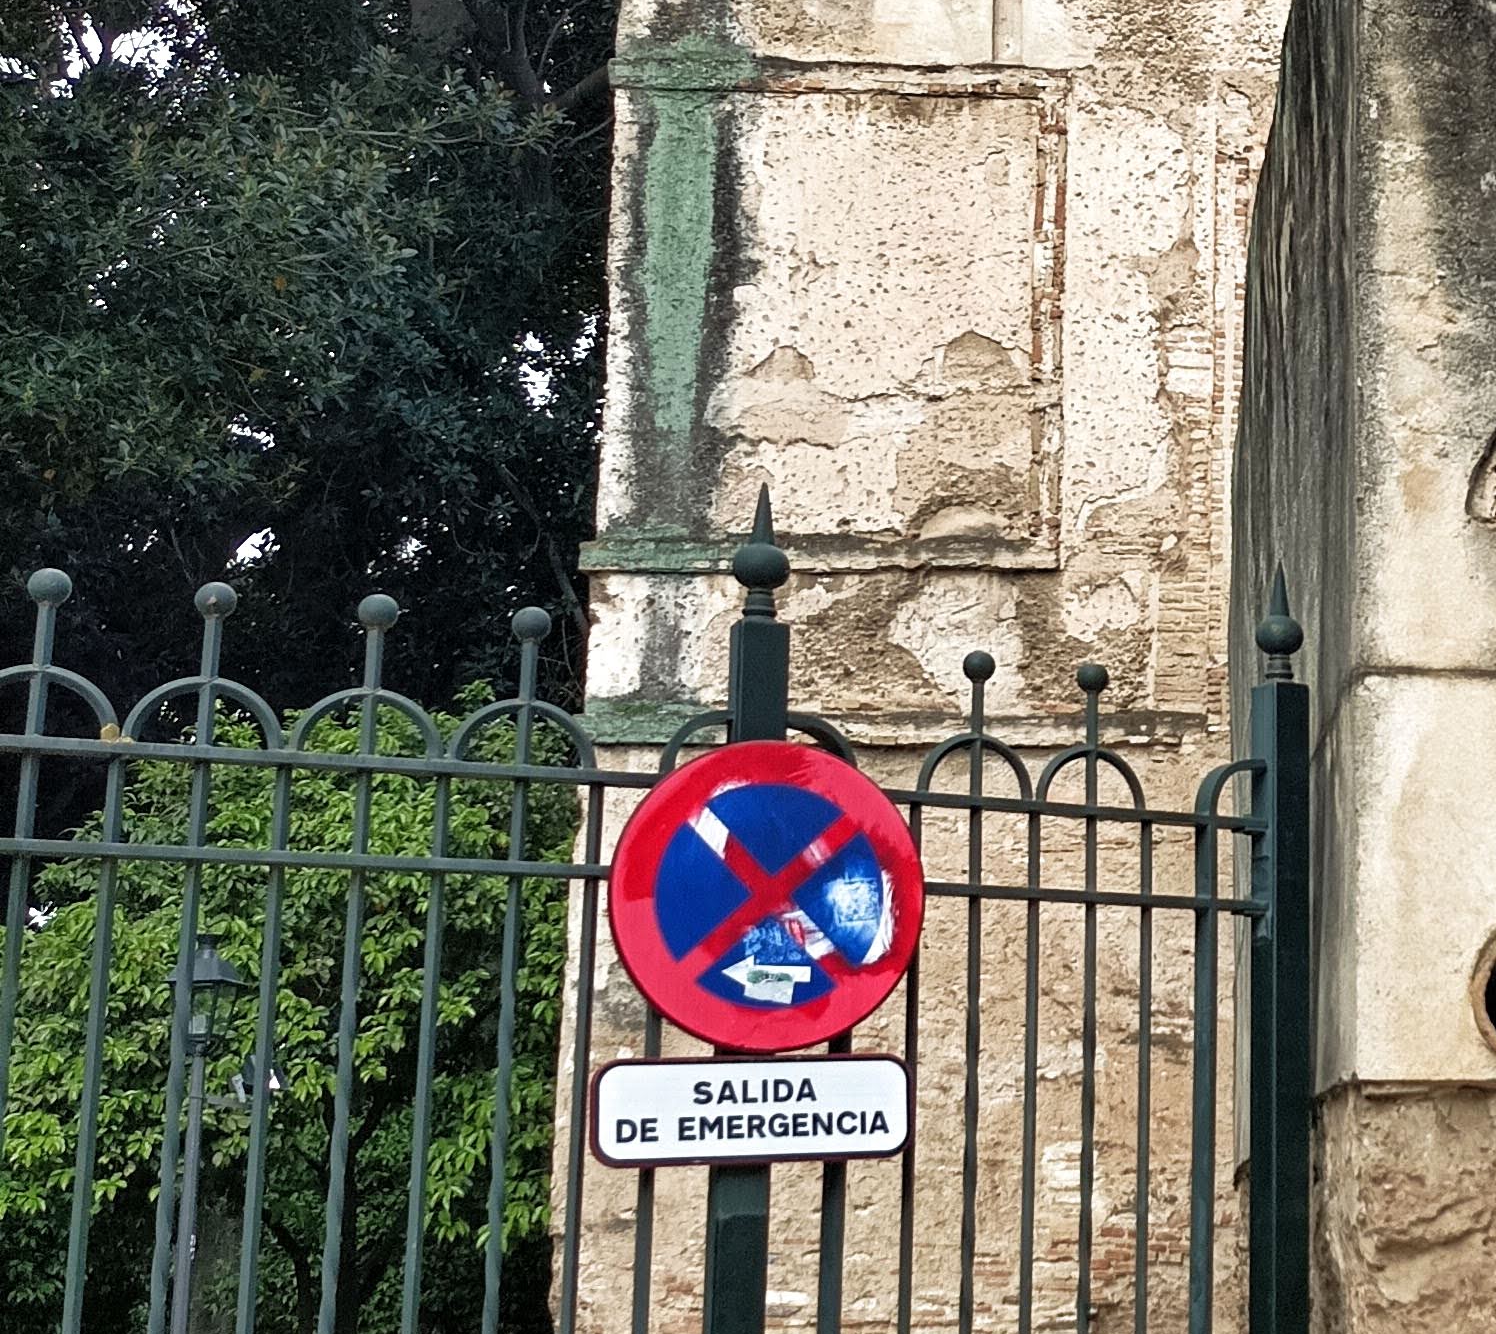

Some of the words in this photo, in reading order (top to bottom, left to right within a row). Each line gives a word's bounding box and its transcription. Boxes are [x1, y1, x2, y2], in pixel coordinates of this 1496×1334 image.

[693, 1078, 817, 1104] SALIDA
[615, 1117, 659, 1143] DE
[678, 1111, 889, 1142] EMERGENCIA
